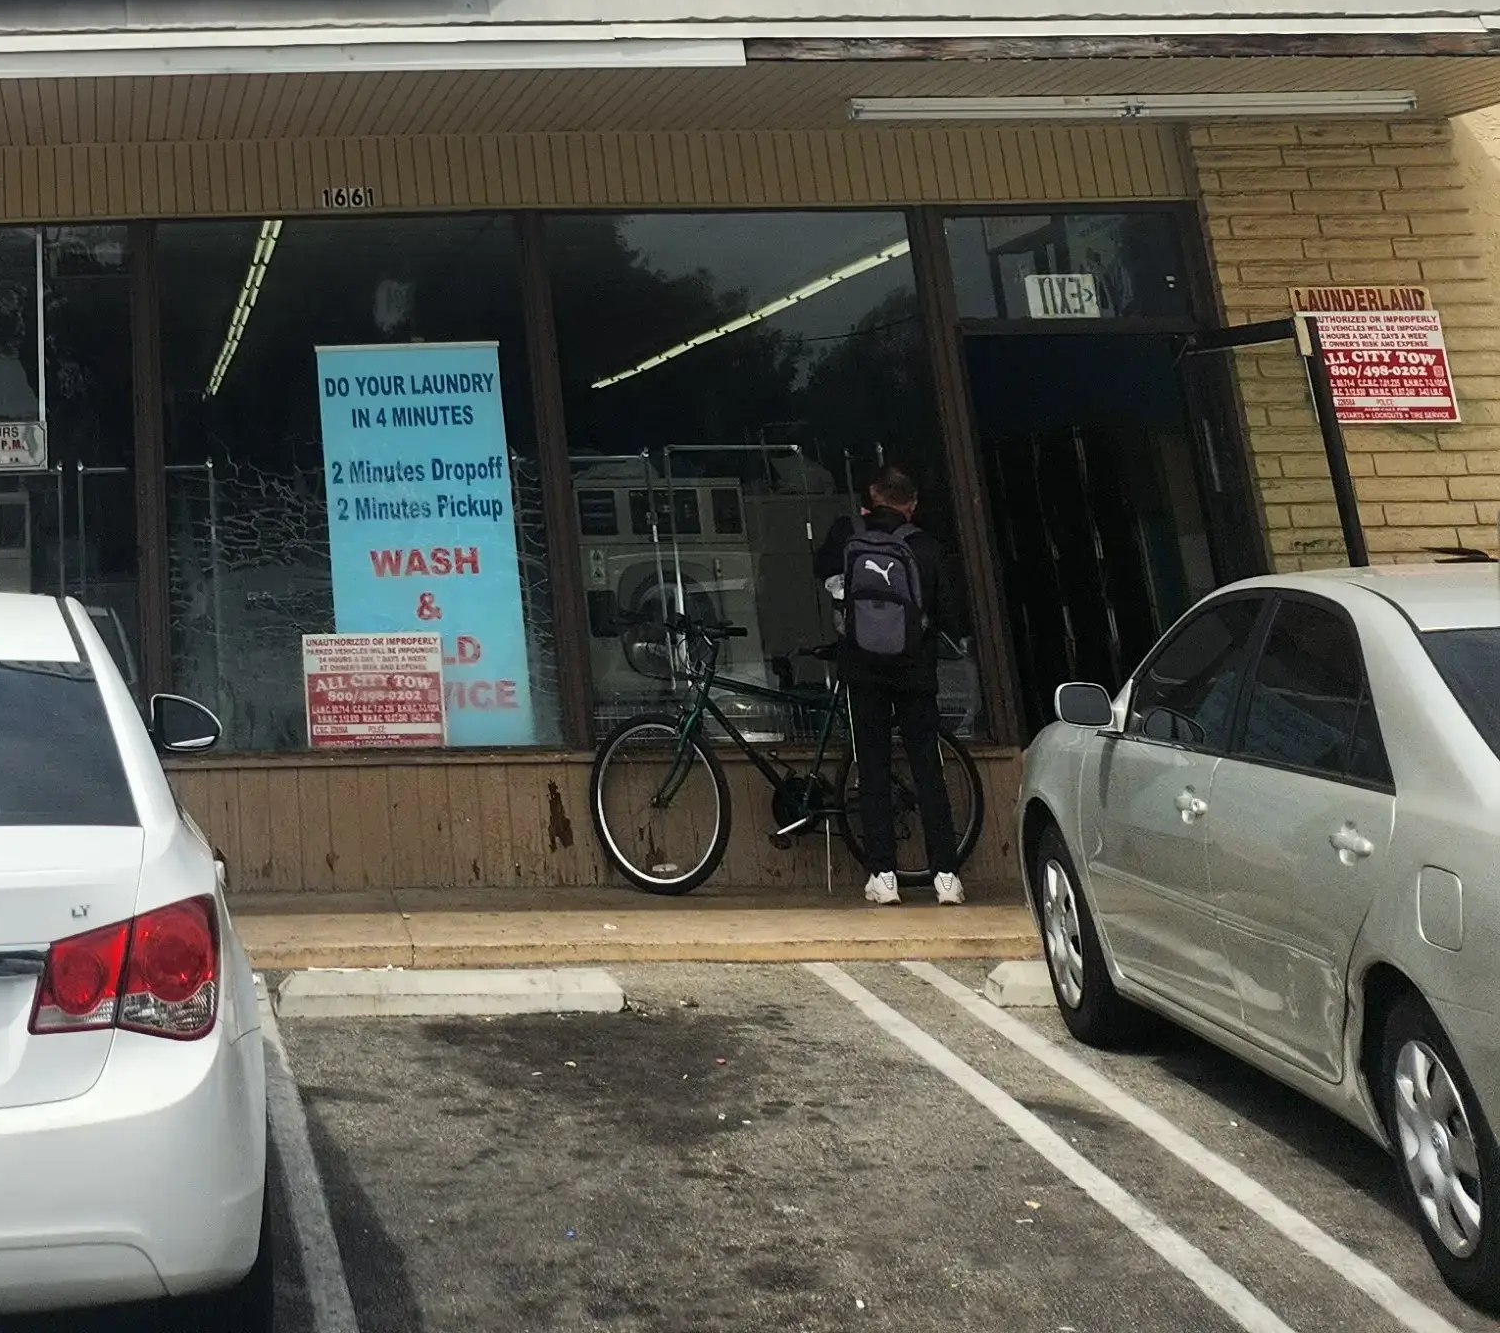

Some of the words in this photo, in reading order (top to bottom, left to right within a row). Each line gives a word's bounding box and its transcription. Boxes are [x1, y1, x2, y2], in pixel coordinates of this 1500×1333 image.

[323, 188, 374, 207] 1661
[1295, 289, 1425, 312] LAUNDERLAND
[1383, 315, 1437, 323] IMPROPERLY
[1351, 351, 1393, 363] CITY
[1395, 351, 1437, 366] TOW
[1330, 365, 1428, 378] 800/498-0202
[325, 377, 350, 397] DO
[355, 375, 406, 396] YOUR
[410, 373, 494, 395] LAUNDRY
[352, 408, 371, 428] IN
[376, 407, 387, 427] 4
[392, 405, 474, 427] MINUTES
[1, 440, 25, 450] P.M.
[332, 461, 344, 484] 2
[349, 460, 426, 483] Minutes
[431, 456, 503, 485] Dropoff
[337, 498, 349, 521] 2
[355, 497, 432, 521] Minutes
[437, 494, 503, 522] Pickup
[370, 547, 481, 578] WASH
[417, 593, 443, 621] &
[306, 638, 371, 647] UNAUTHORIZED
[386, 637, 438, 645] IMPROPERLY
[315, 676, 348, 692] ALL
[351, 674, 389, 688] CITY
[394, 674, 433, 689] TOW
